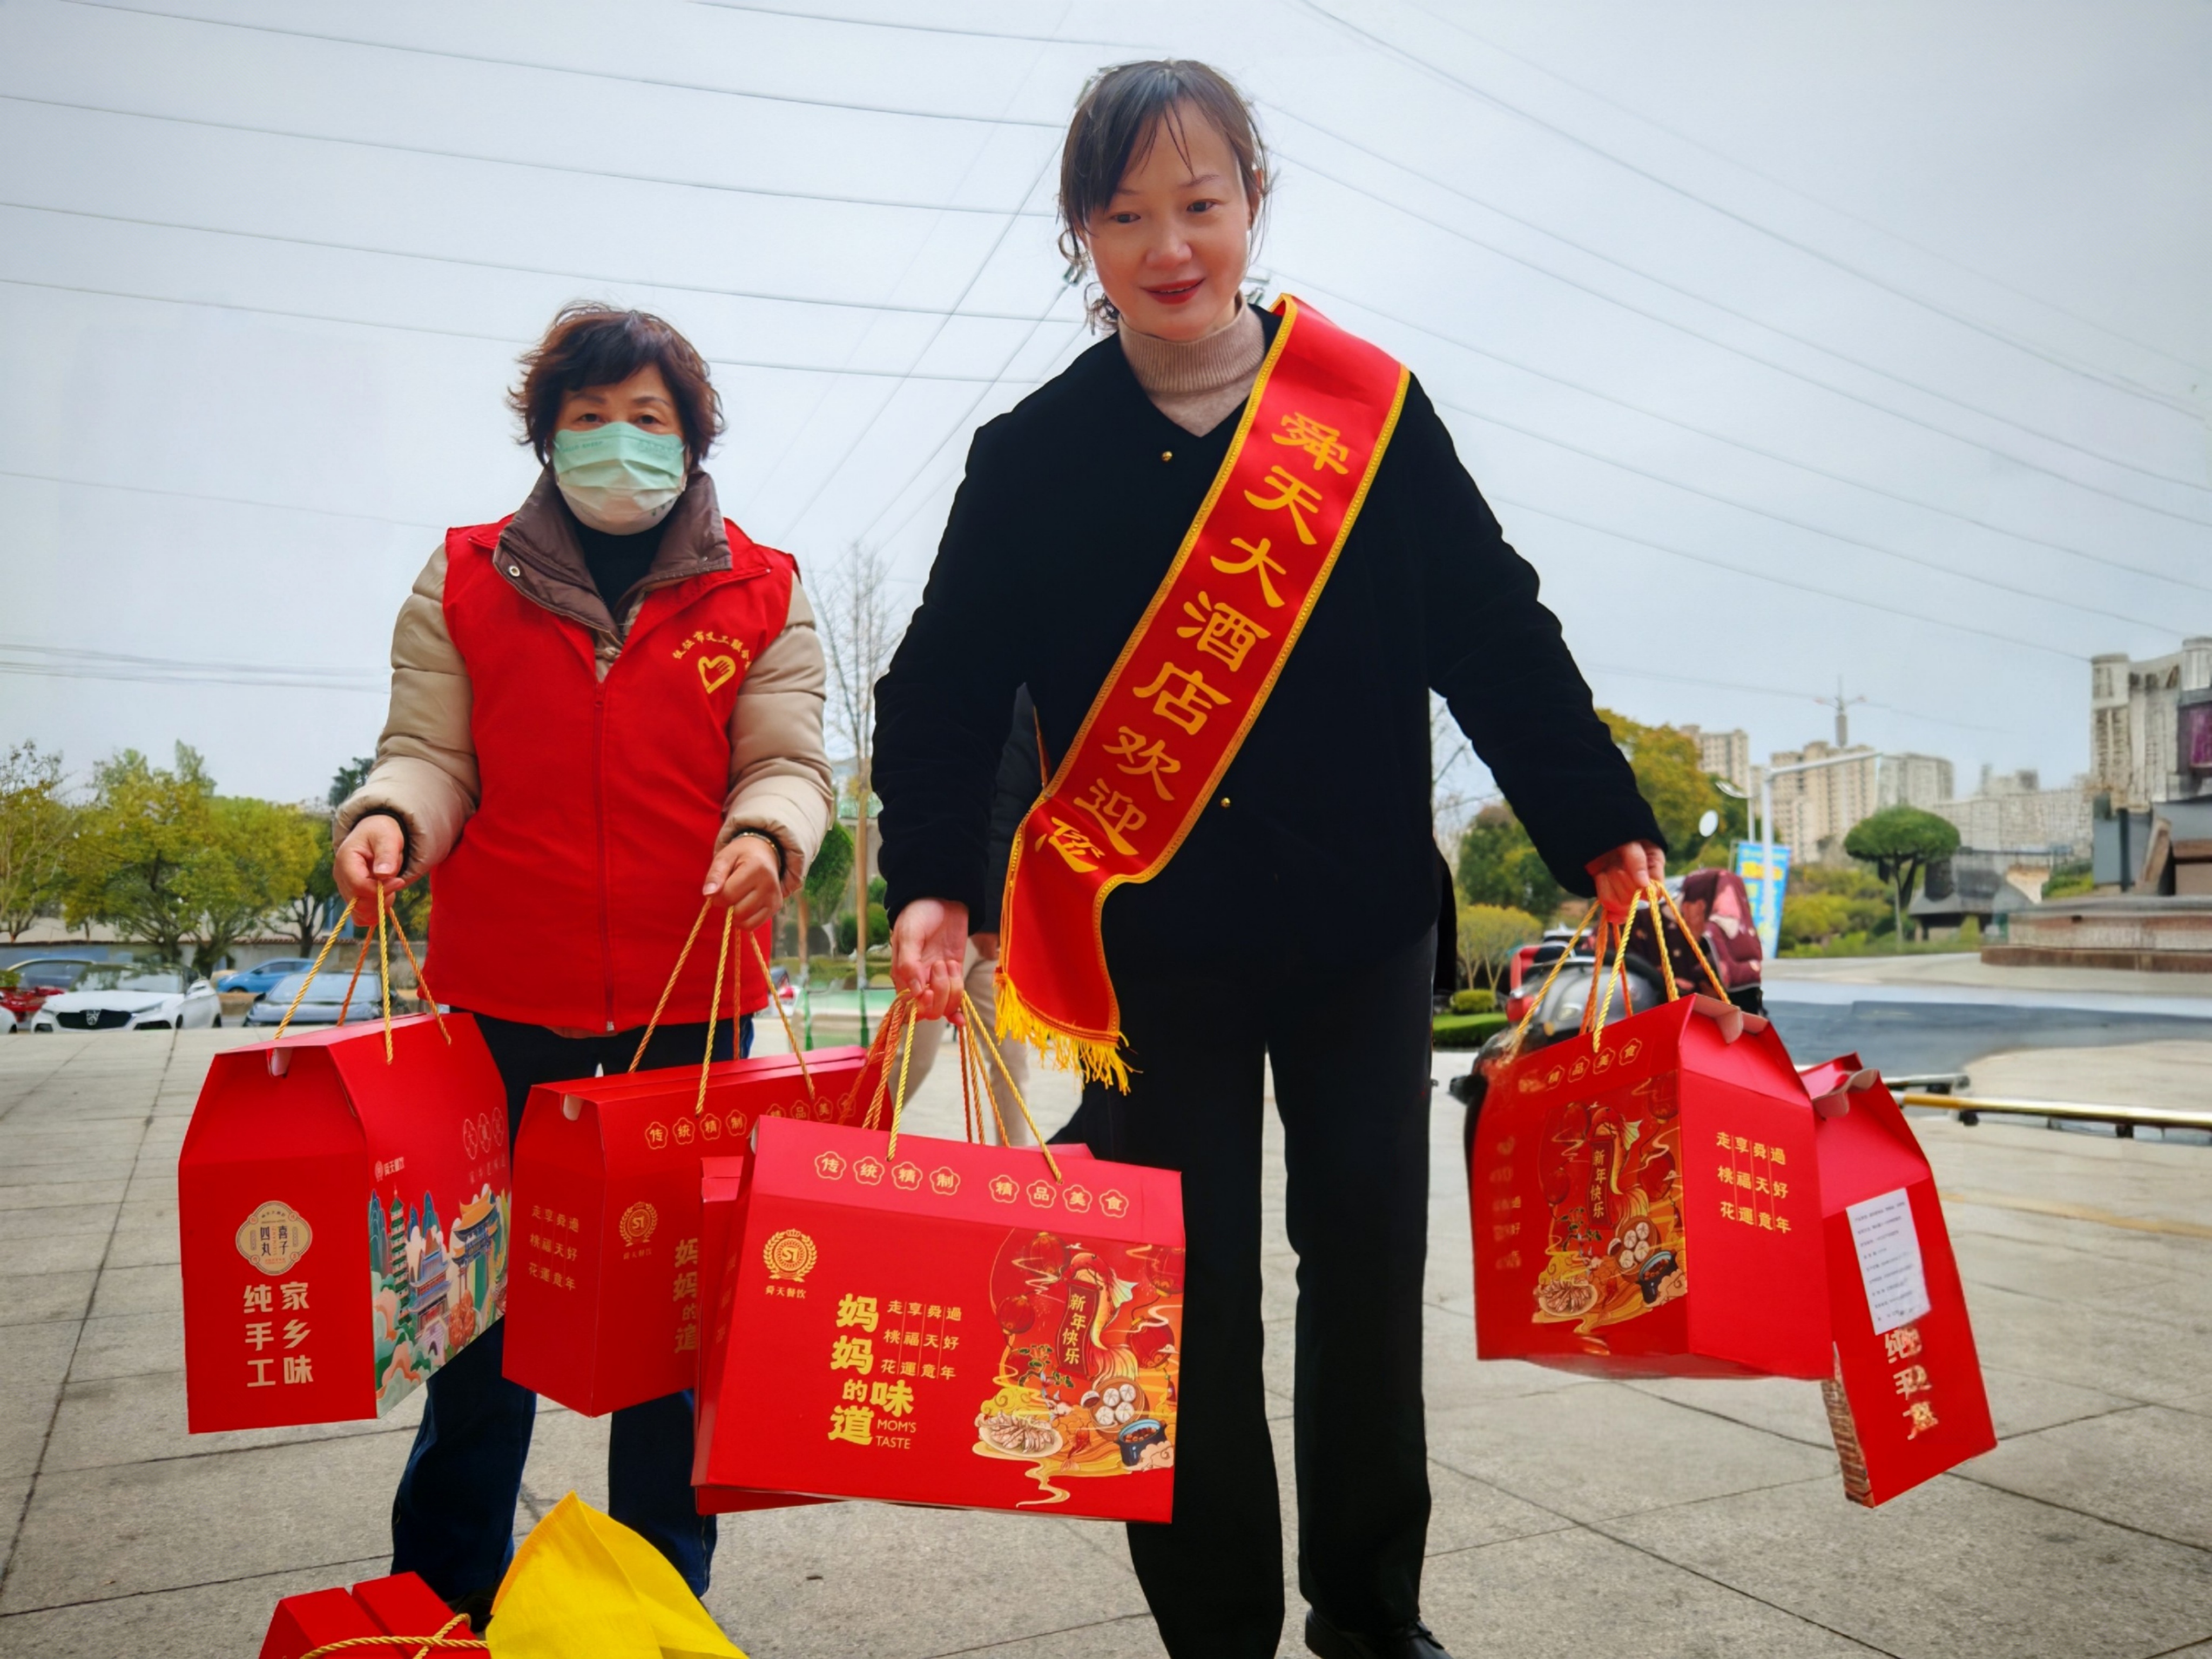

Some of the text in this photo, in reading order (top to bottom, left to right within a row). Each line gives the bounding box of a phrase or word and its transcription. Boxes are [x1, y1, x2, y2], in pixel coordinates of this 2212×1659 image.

[650, 1116, 743, 1143] 传统精制
[821, 1157, 1122, 1211] 传统精制 精品美食
[1590, 1149, 1607, 1218] 新年快乐
[765, 1285, 807, 1299] 舜天餐饮
[1062, 1293, 1086, 1365] 新年快乐
[876, 1419, 916, 1433] MOM'S
[875, 1435, 911, 1449] TASTE
